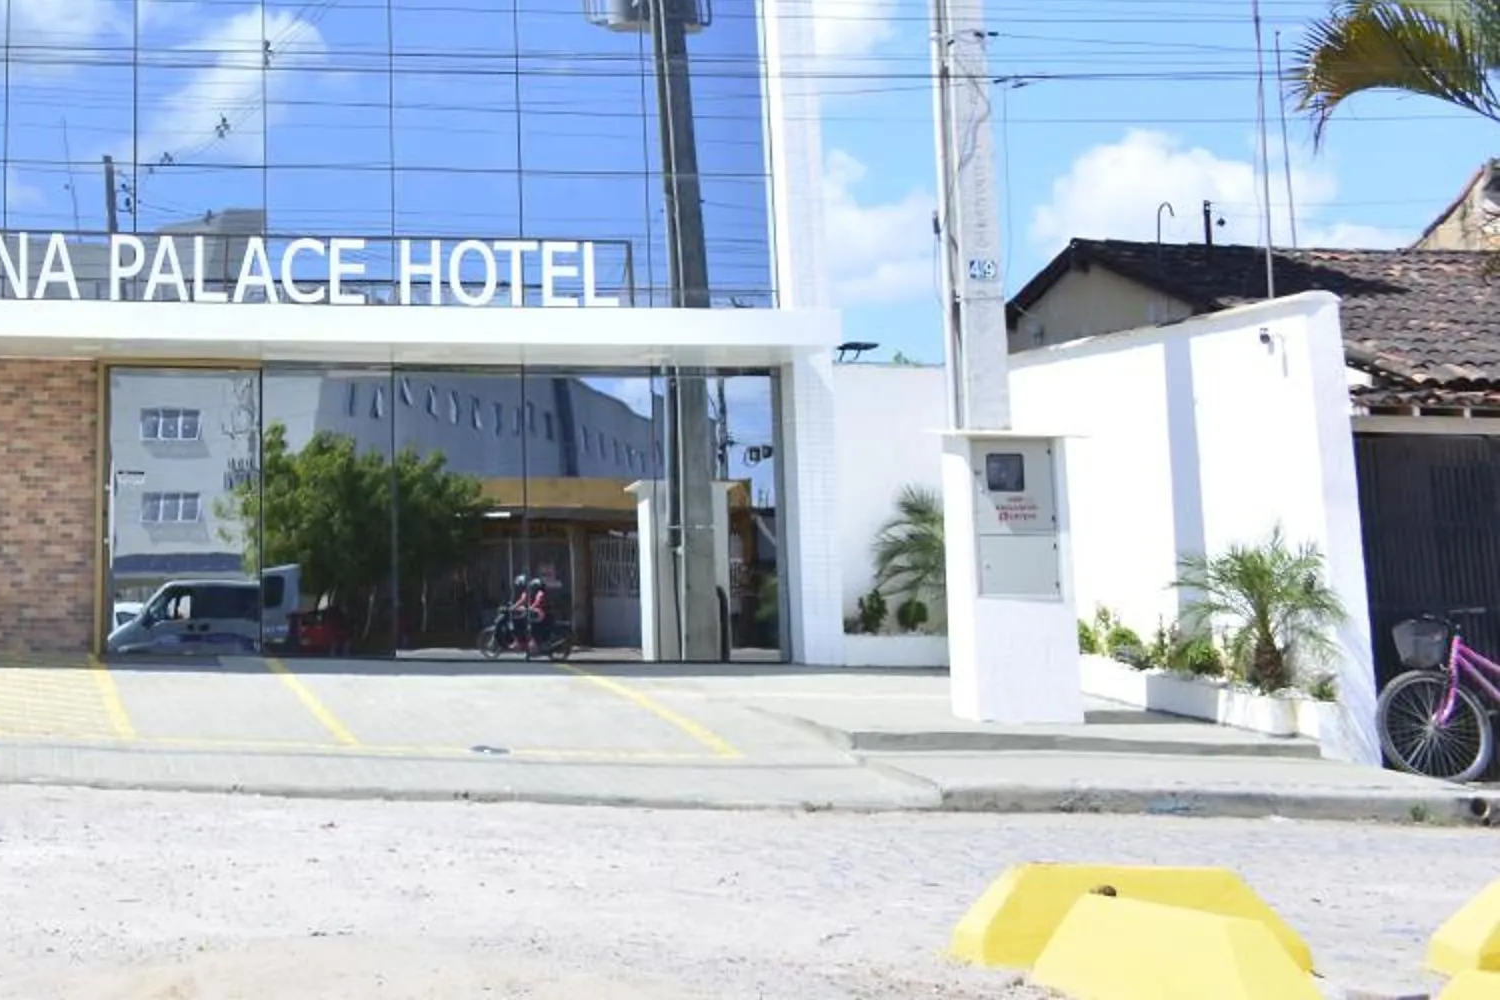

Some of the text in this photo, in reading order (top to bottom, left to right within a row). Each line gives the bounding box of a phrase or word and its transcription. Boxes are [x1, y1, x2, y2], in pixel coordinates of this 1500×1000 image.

[110, 234, 365, 304] PALACE
[400, 239, 619, 307] HOTEL
[970, 259, 996, 279] 49
